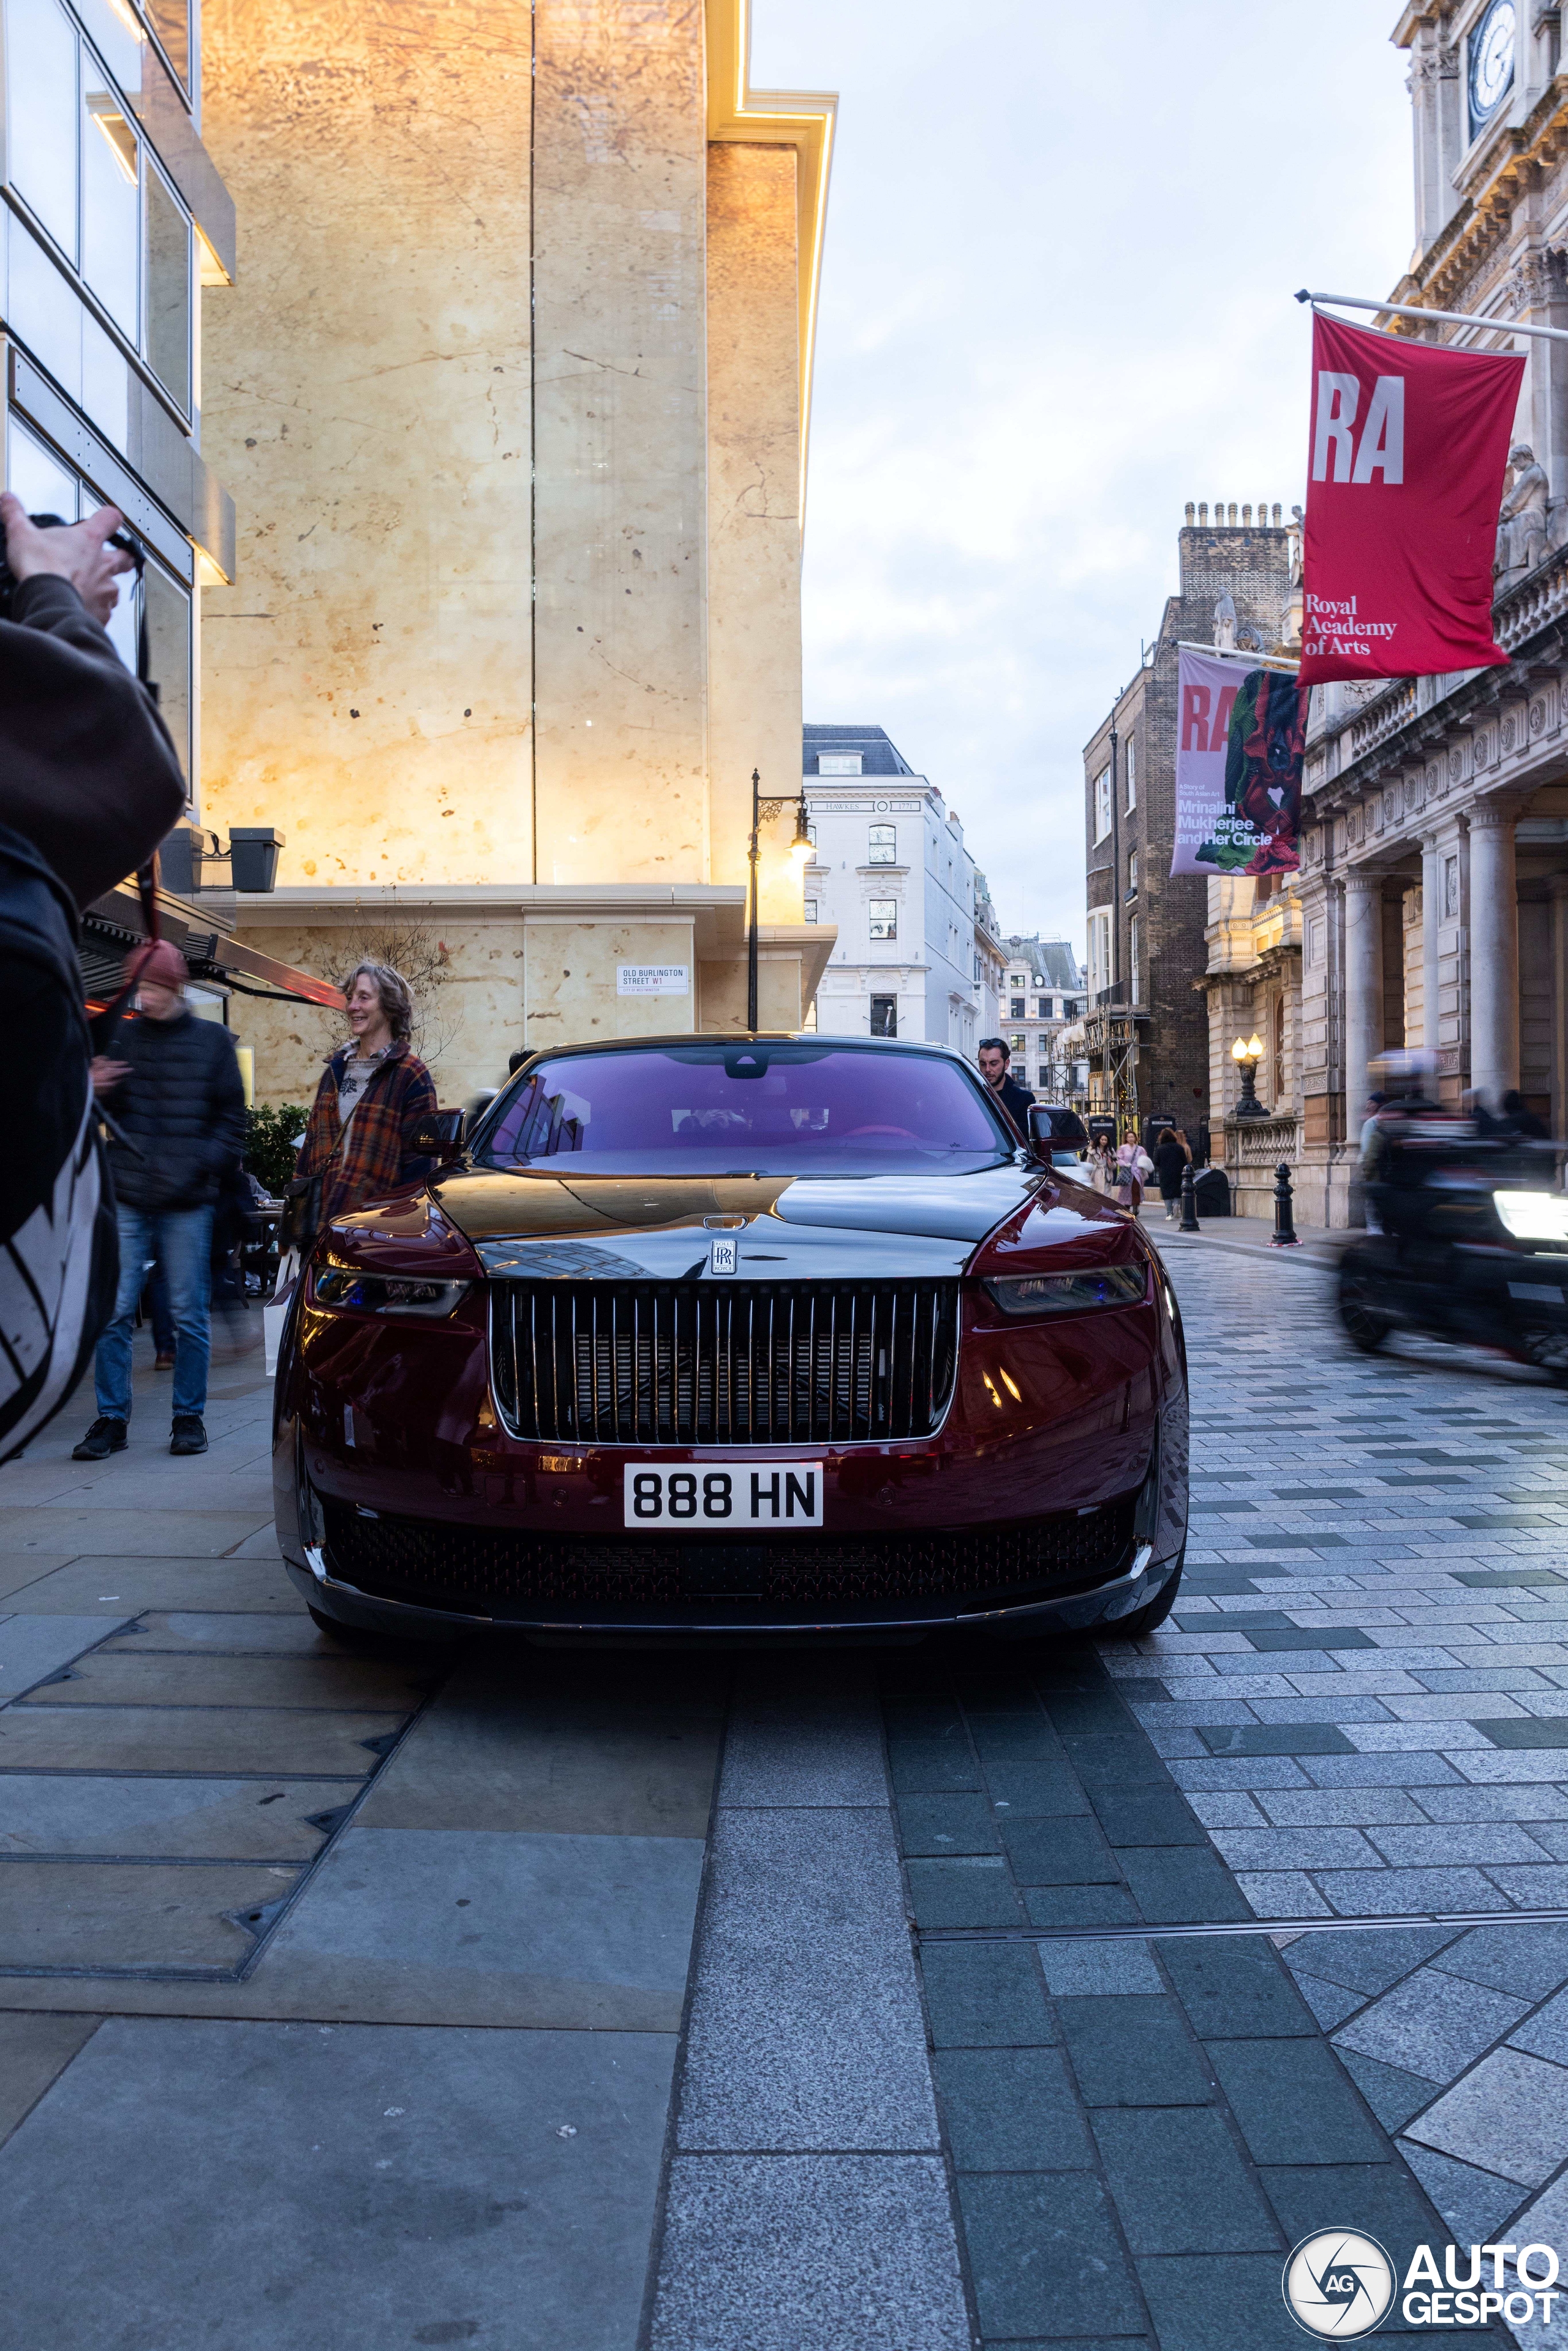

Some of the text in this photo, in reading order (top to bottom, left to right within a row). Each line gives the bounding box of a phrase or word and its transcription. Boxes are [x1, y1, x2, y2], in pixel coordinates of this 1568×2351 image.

[1312, 370, 1404, 485] RA
[1305, 594, 1358, 619] Royal
[1306, 614, 1398, 640] Academy
[1305, 635, 1371, 655] of Arts
[1182, 684, 1238, 752] RA
[1178, 799, 1235, 815] Mrinalini
[1178, 815, 1254, 833] Mukherjee
[1177, 831, 1272, 846] and Her Circle
[633, 1471, 815, 1519] 888 HN
